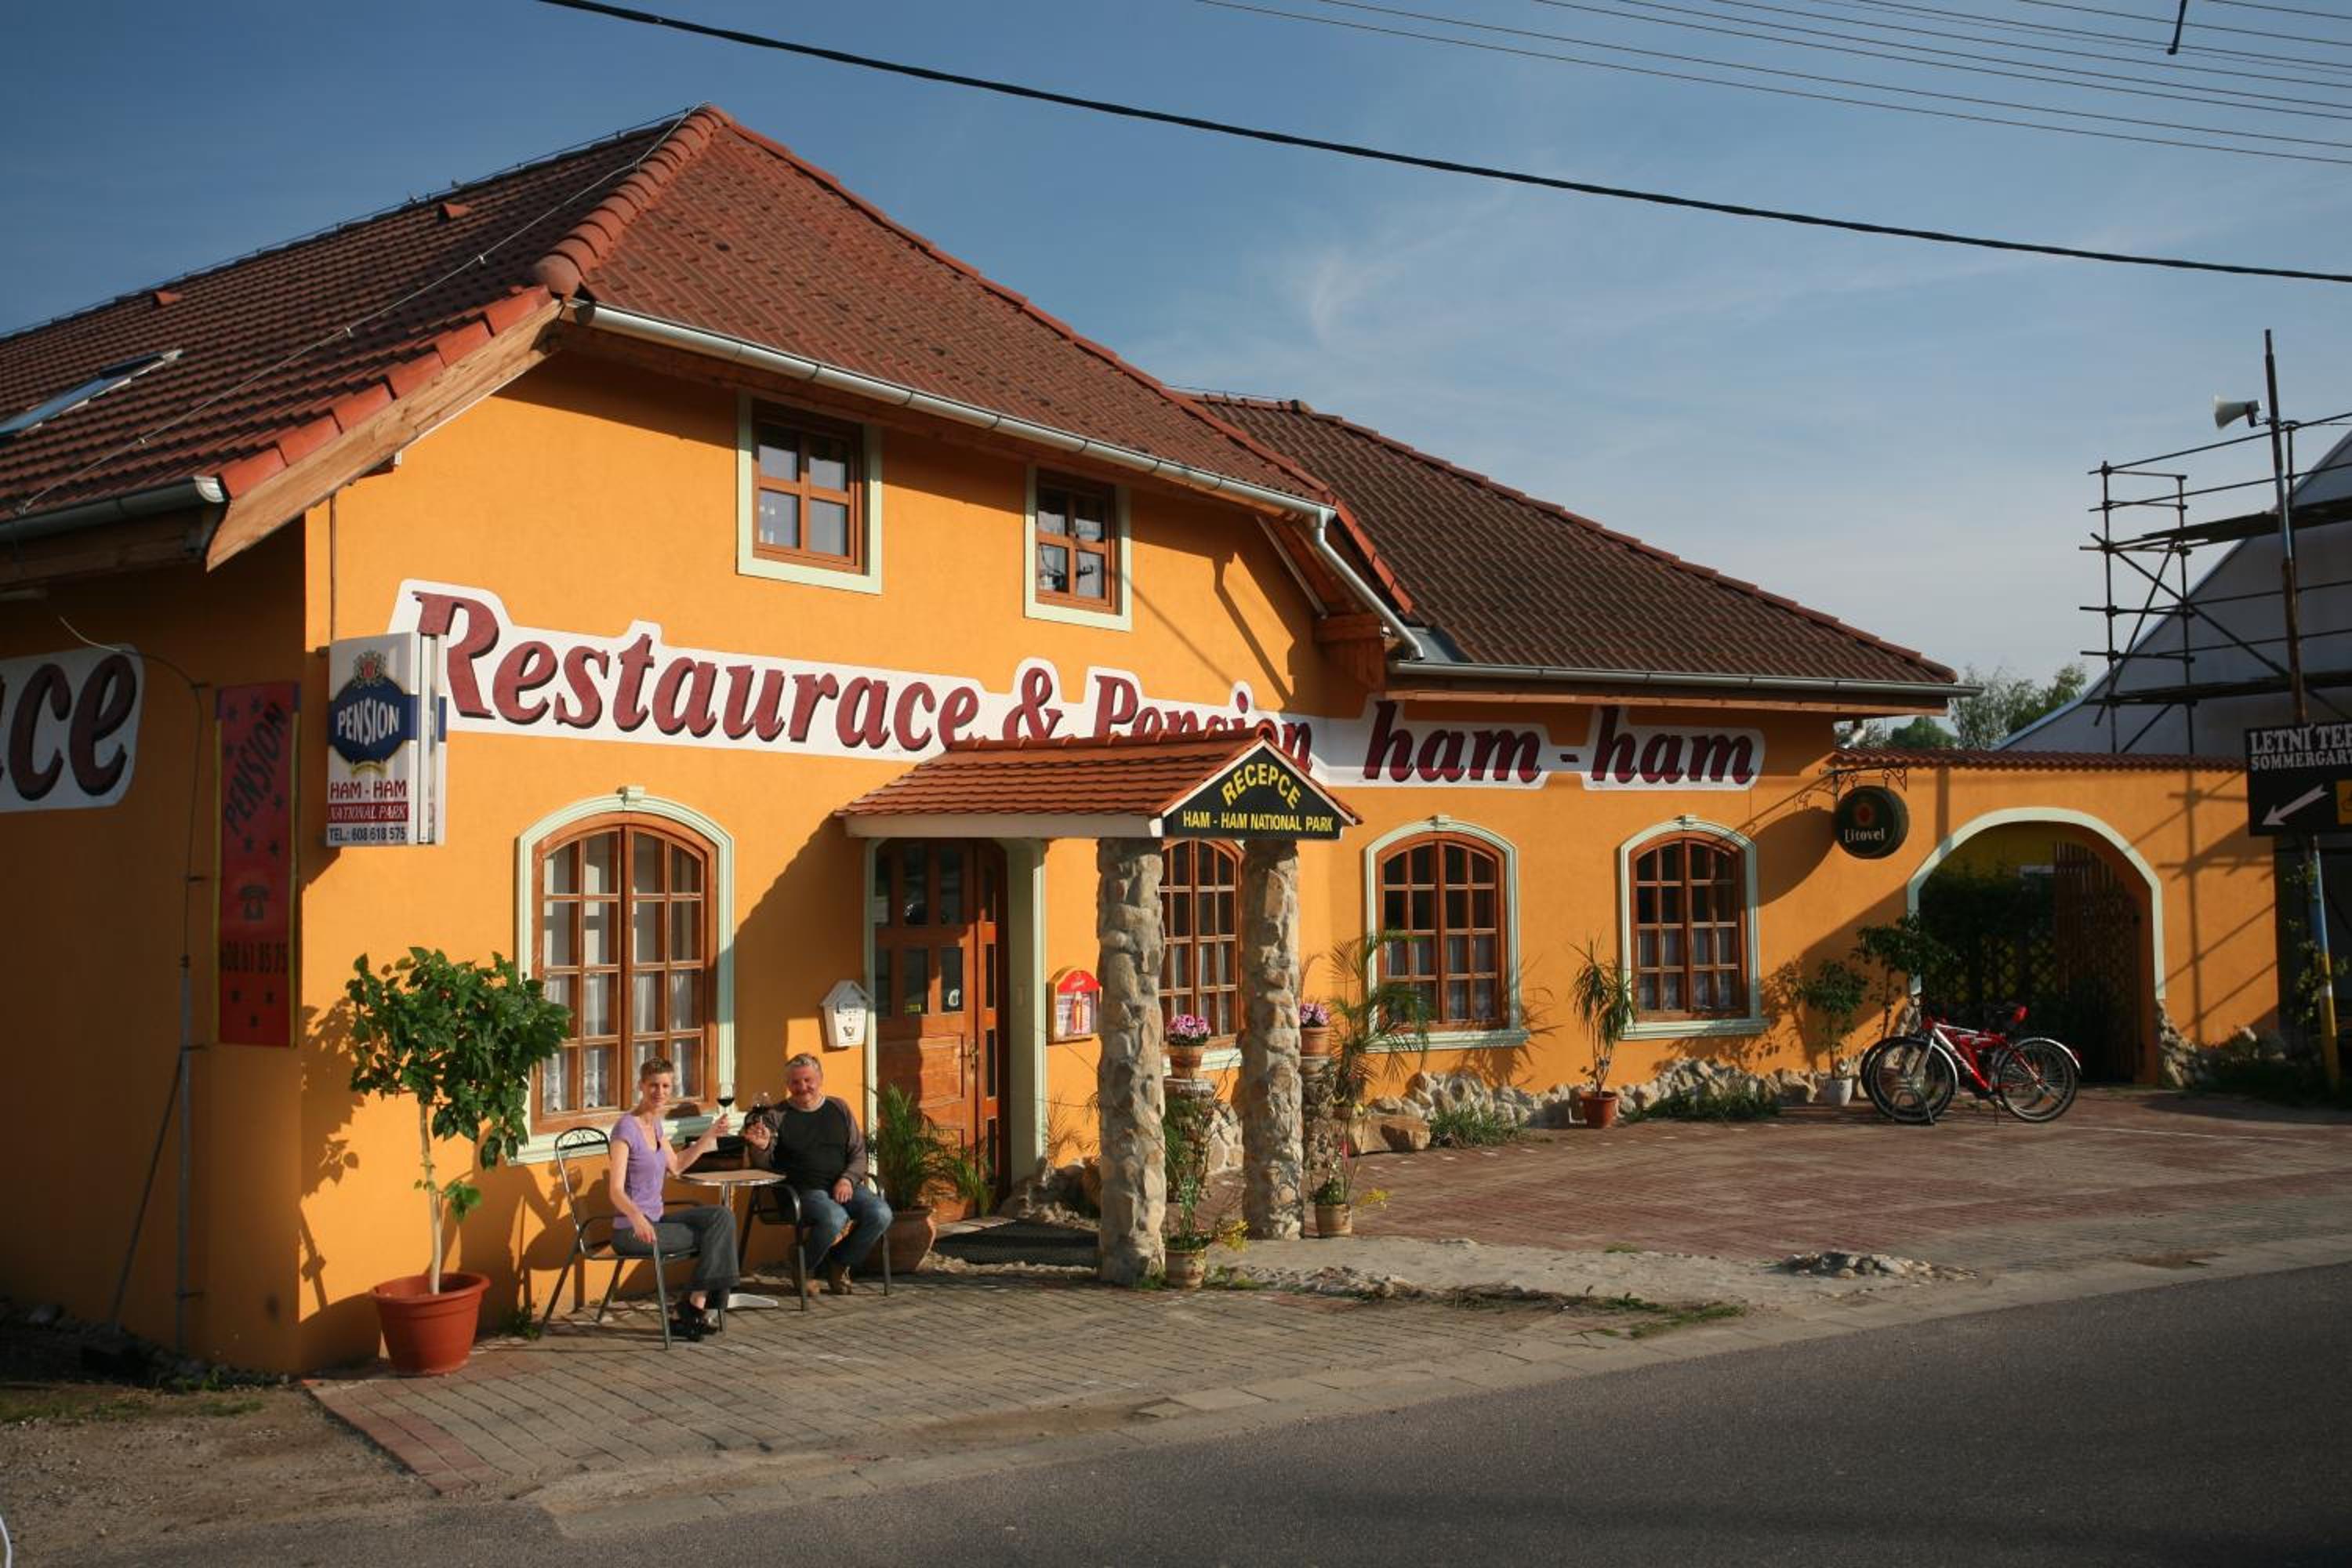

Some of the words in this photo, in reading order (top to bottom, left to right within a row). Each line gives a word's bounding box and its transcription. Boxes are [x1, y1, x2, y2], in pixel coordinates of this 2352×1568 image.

[412, 590, 979, 751] Restaurace
[1002, 667, 1064, 740] &
[1363, 700, 1541, 782] ham
[1591, 705, 1754, 784] ham
[0, 654, 136, 801] ce
[338, 697, 399, 746] PENSION
[2250, 723, 2314, 754] LETNÍ
[225, 700, 288, 836] PENSION
[330, 781, 361, 800] HAM
[373, 779, 406, 798] HAM
[1221, 763, 1301, 809] RECEPCE
[329, 804, 377, 821] NATIONAL
[379, 804, 407, 819] PARK
[1183, 810, 1210, 828] HAM
[1221, 812, 1247, 829] HAM
[1250, 814, 1302, 831] NATIONAL
[1305, 816, 1333, 831] PARK
[370, 827, 387, 840] 618
[1845, 827, 1885, 843] Litovel
